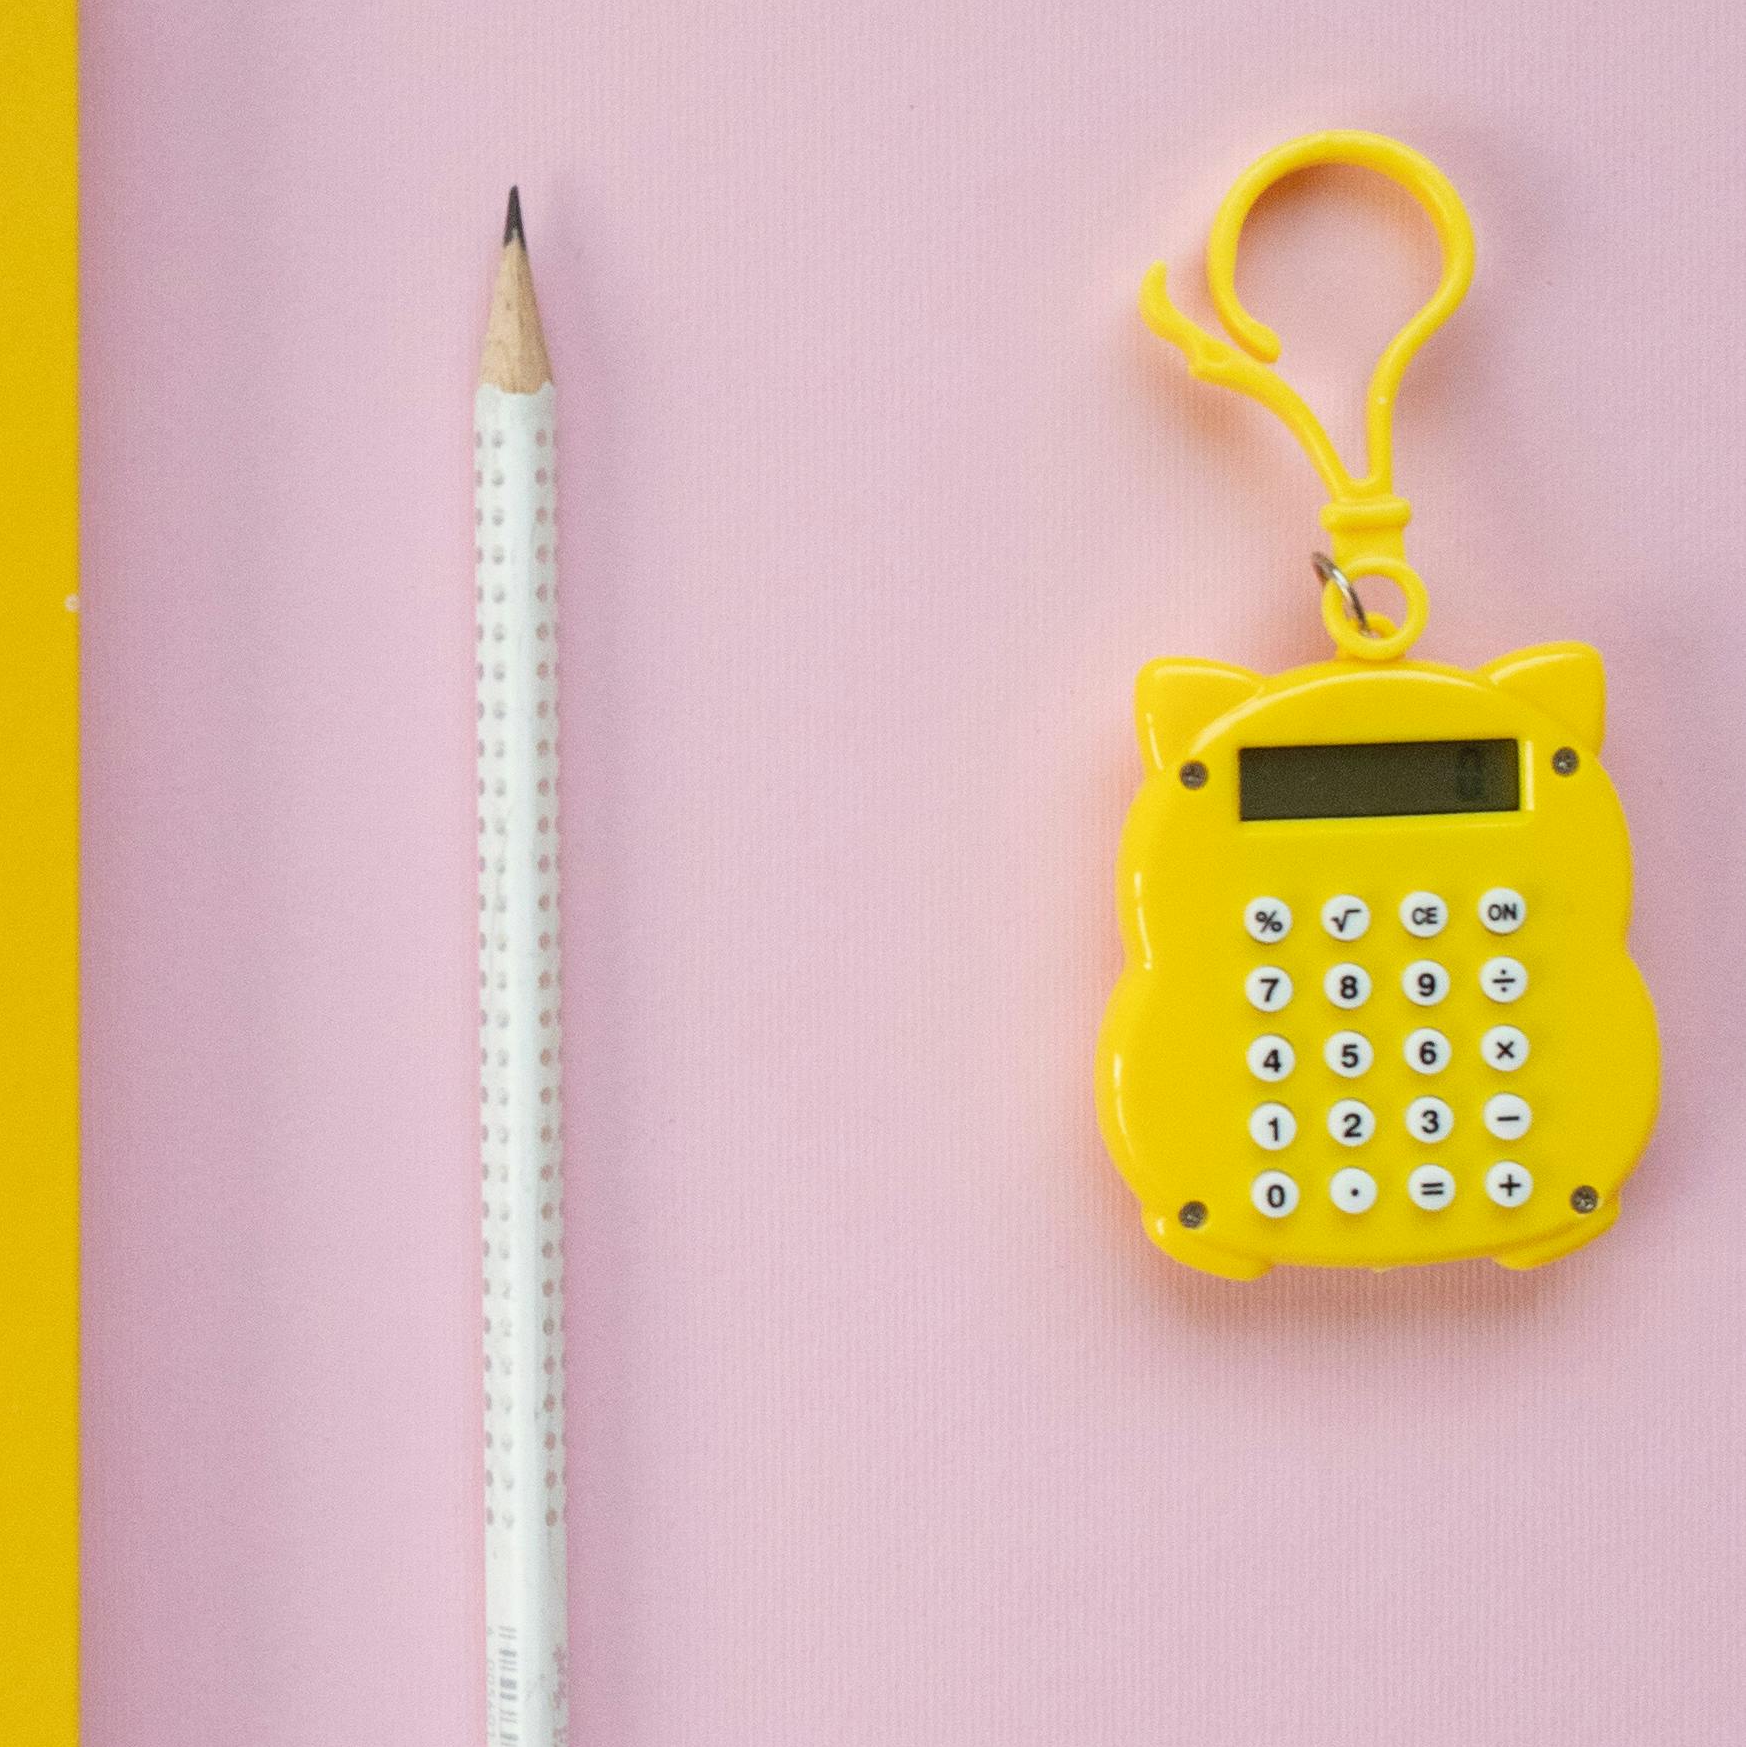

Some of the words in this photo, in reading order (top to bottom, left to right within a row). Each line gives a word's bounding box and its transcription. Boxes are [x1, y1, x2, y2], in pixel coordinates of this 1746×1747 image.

[1255, 911, 1284, 933] %
[1412, 906, 1438, 926] CE
[1488, 903, 1518, 922] ON
[1260, 977, 1280, 1003] 7
[1340, 975, 1359, 1000] 8
[1417, 972, 1437, 998] 9
[1263, 1048, 1282, 1073] 4
[1341, 1043, 1359, 1069] 5
[1419, 1040, 1437, 1066] 6
[1268, 1117, 1279, 1142] 1
[1343, 1112, 1362, 1139] 2
[1421, 1109, 1440, 1135] 3
[1266, 1184, 1286, 1209] 0
